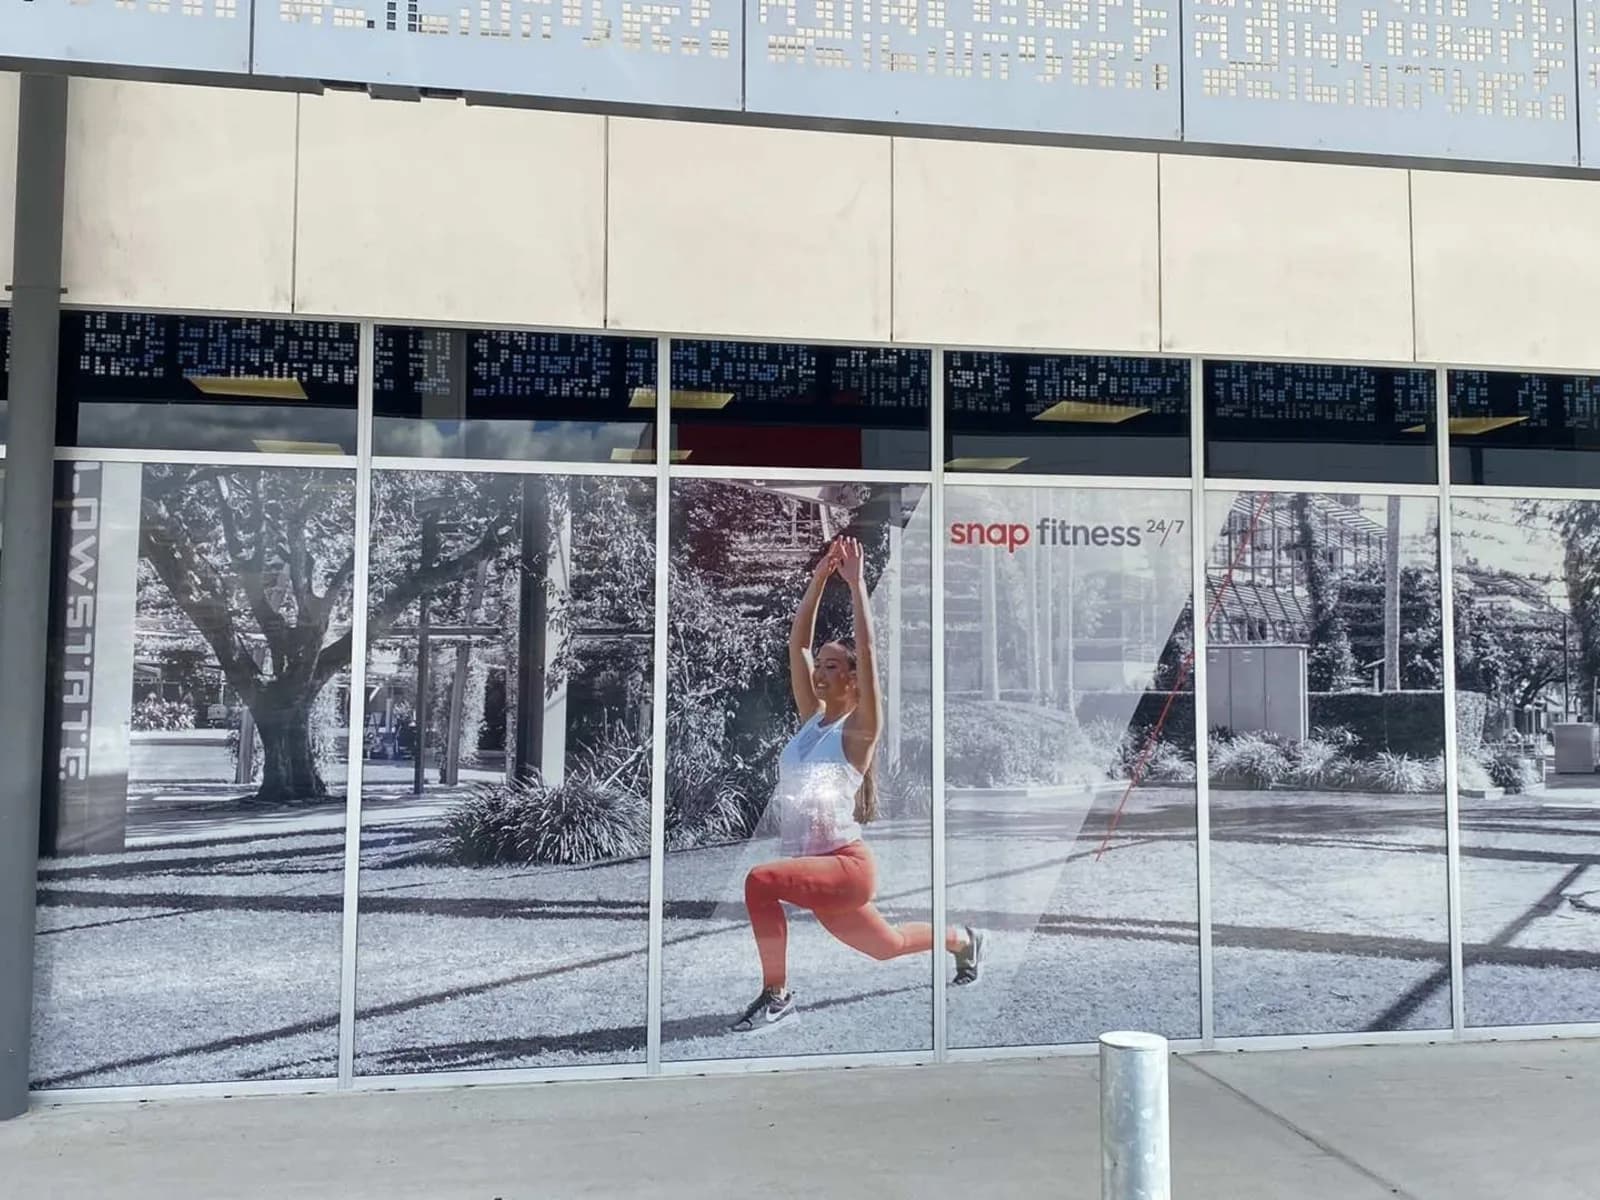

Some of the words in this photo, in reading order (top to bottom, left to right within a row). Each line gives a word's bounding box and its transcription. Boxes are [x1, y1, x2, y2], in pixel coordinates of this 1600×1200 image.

[950, 521, 1030, 553] snap
[1036, 518, 1141, 547] fitness
[1146, 519, 1185, 547] 24/7
